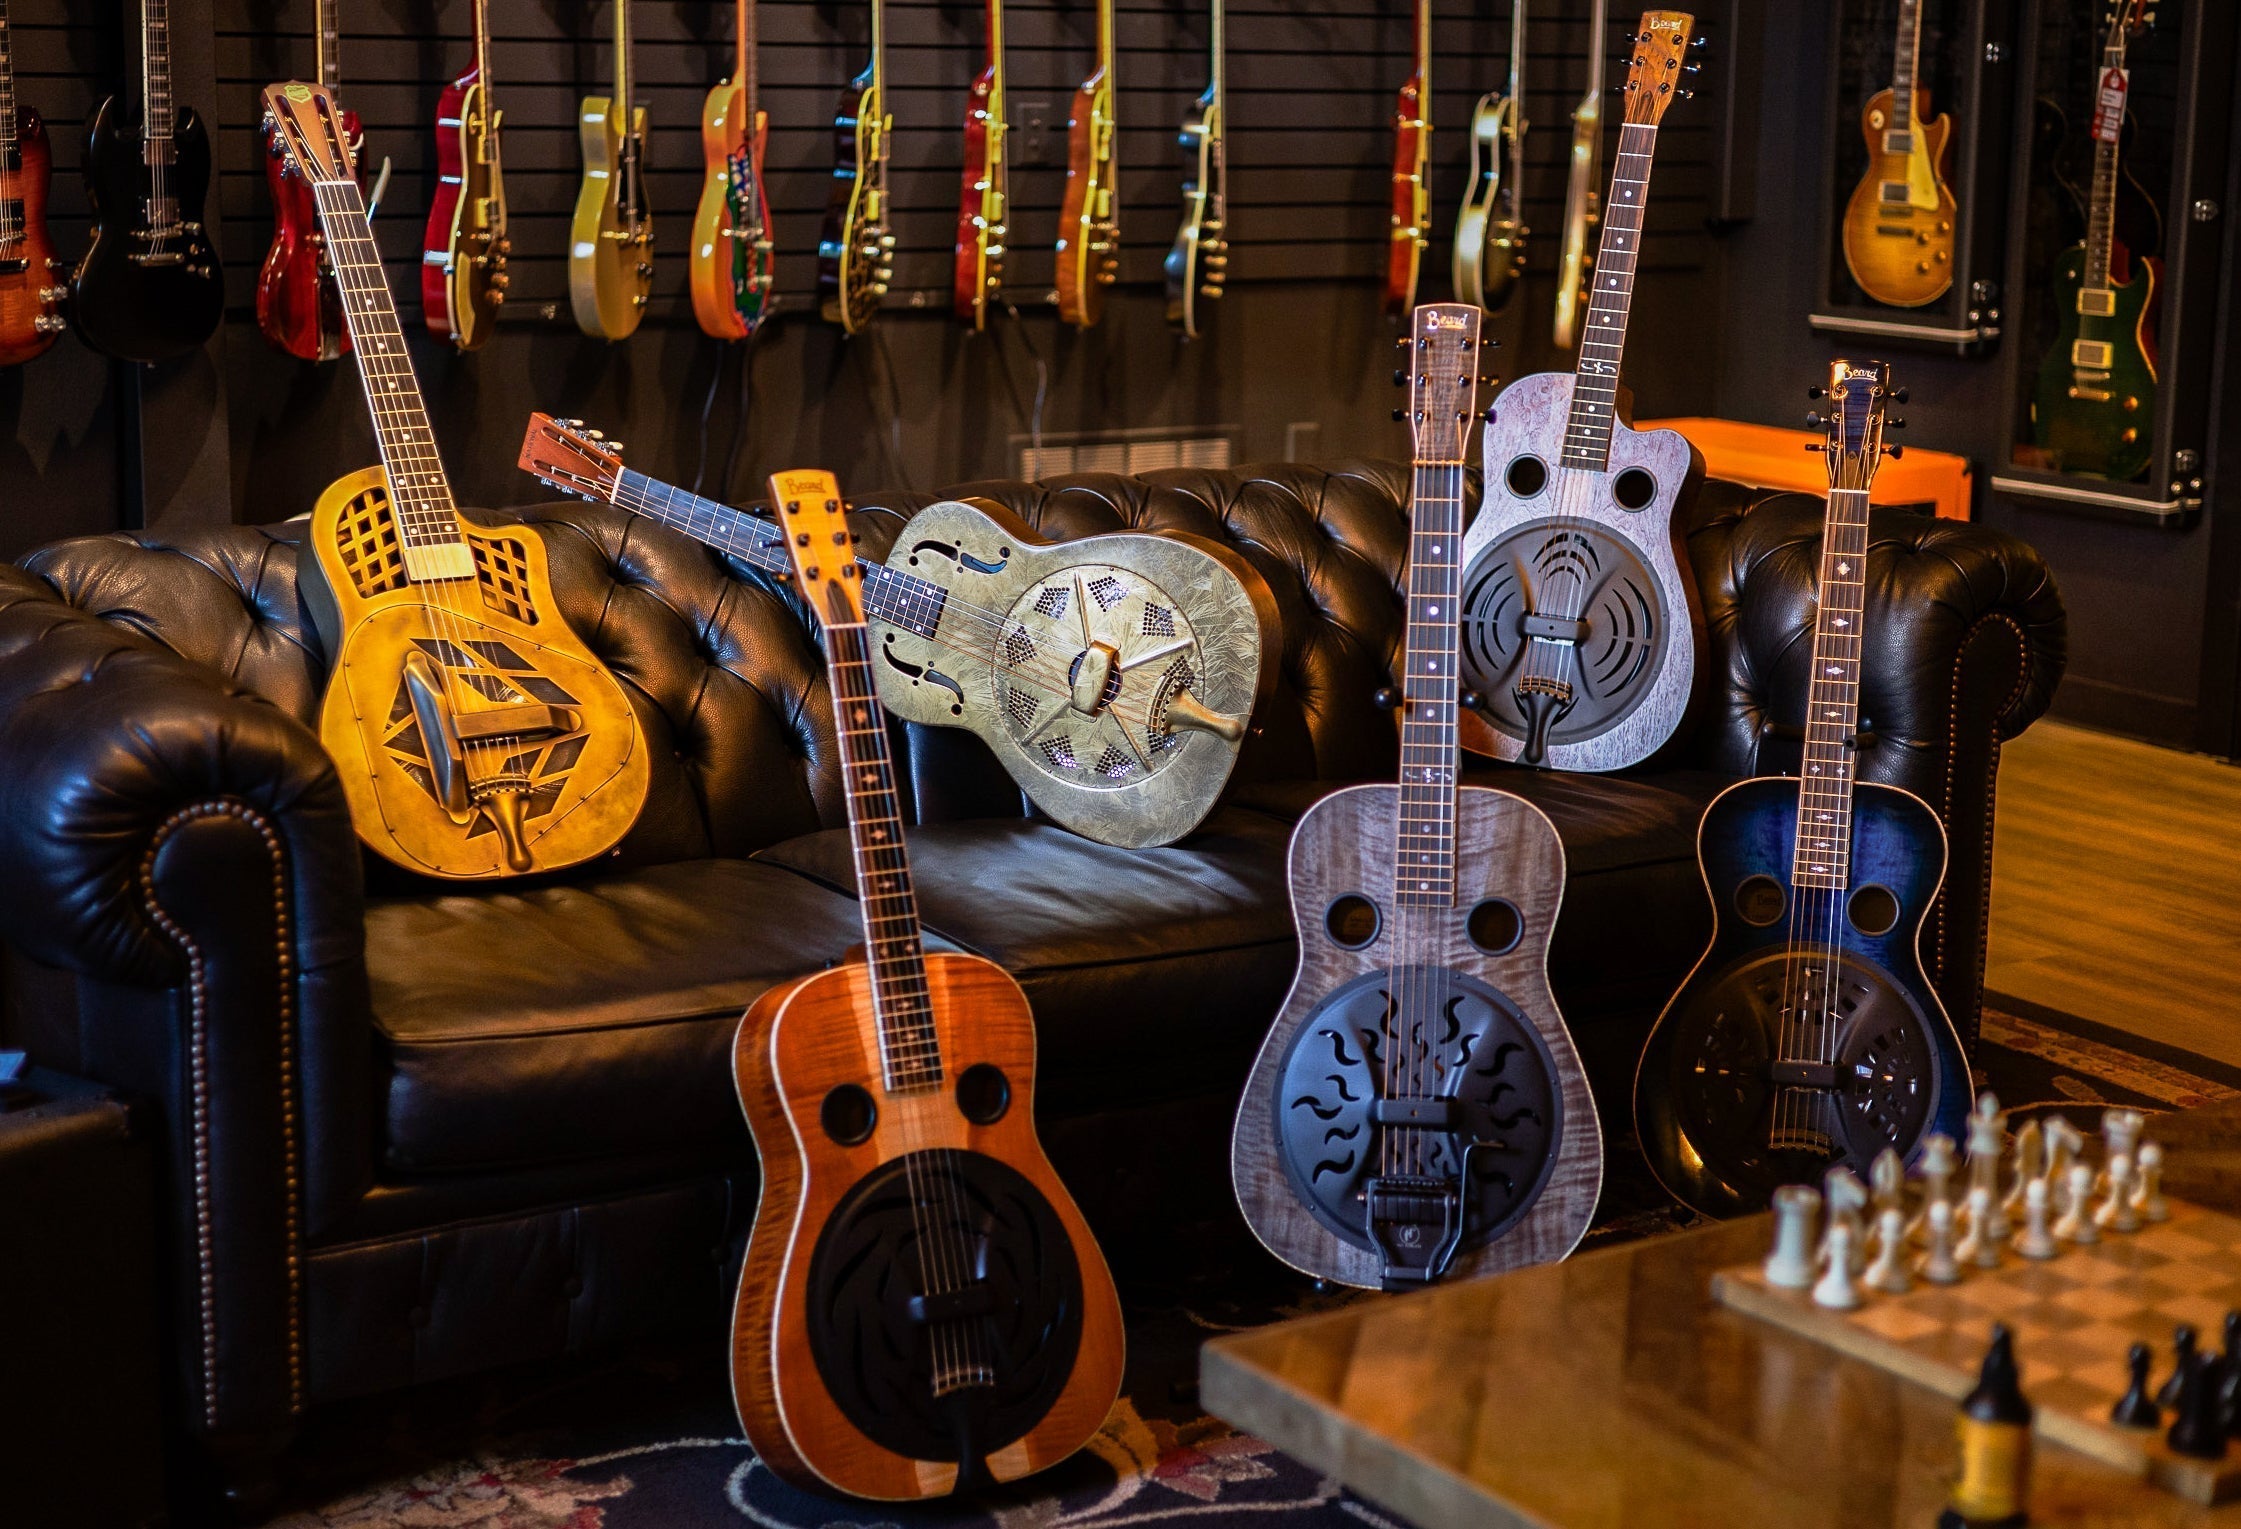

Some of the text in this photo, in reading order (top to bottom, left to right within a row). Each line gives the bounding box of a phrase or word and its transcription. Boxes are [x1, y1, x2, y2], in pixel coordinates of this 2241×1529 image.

[1427, 310, 1468, 329] Beard
[1840, 364, 1877, 381] Beard
[785, 478, 825, 494] Beard
